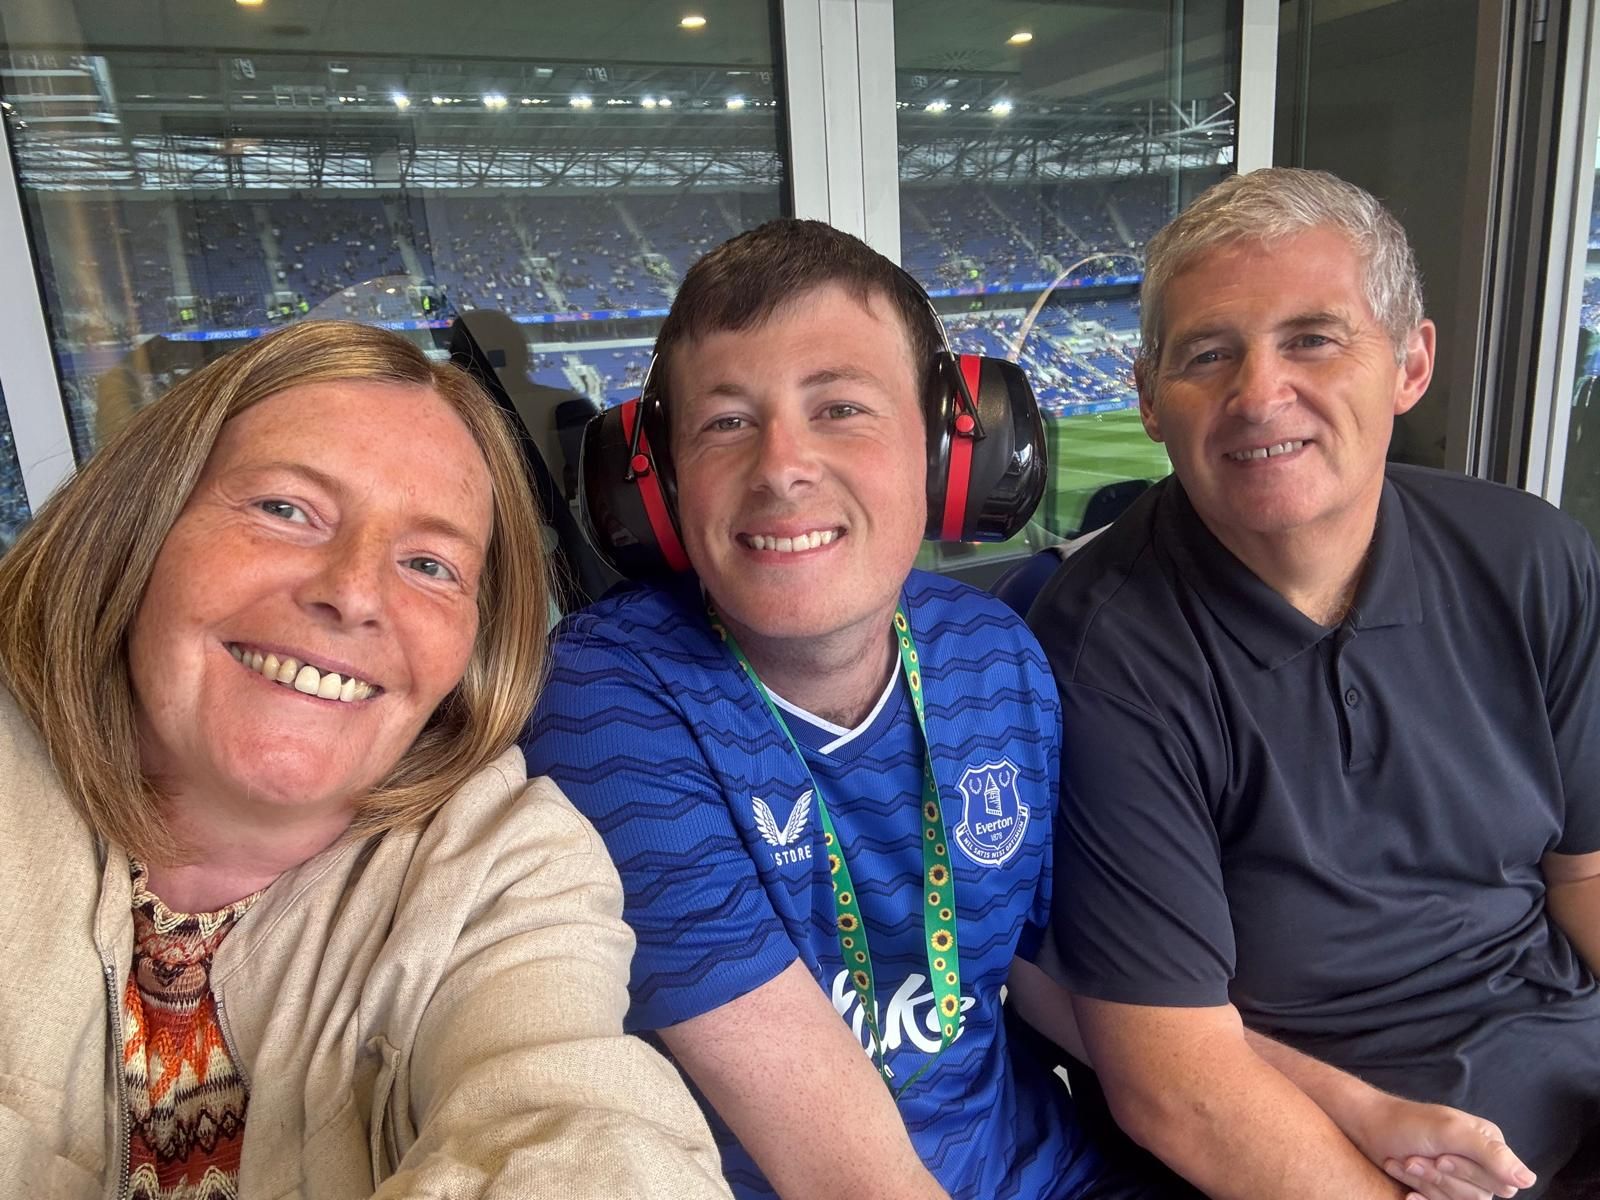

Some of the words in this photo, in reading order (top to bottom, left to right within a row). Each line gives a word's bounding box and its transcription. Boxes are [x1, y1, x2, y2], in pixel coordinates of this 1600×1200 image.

[975, 816, 1013, 835] Everton
[963, 837, 974, 851] NIL
[973, 847, 990, 859] SATIS
[991, 848, 1006, 859] NISI
[1005, 820, 1025, 852] OPTIMUM
[990, 831, 1003, 842] 1878
